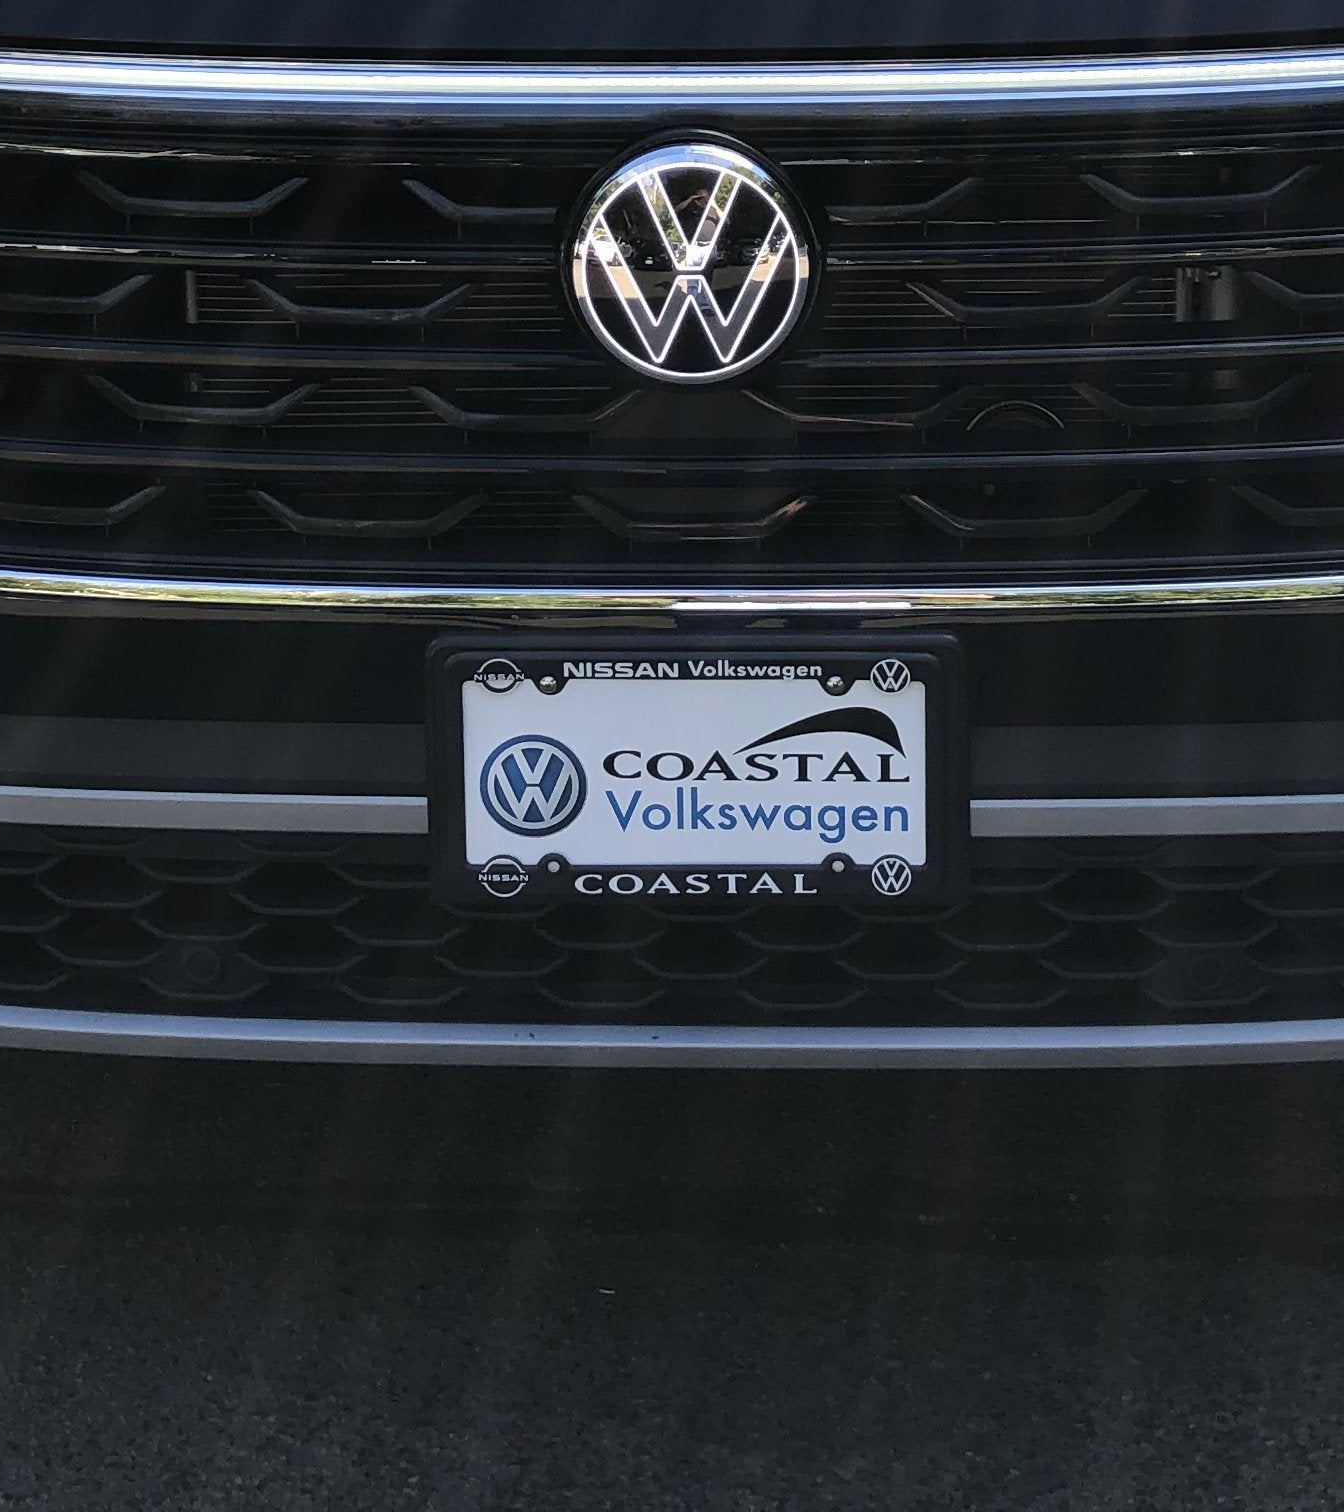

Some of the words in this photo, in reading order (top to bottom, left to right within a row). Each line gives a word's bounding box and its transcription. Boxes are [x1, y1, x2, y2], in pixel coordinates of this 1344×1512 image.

[474, 671, 525, 684] NISSAN
[563, 662, 679, 678] NISSAN
[687, 660, 823, 680] Volkswagen
[602, 750, 910, 782] COASTAL
[605, 787, 910, 844] Volkswagen
[478, 872, 529, 883] NISSAN
[574, 872, 818, 895] COASTAL
